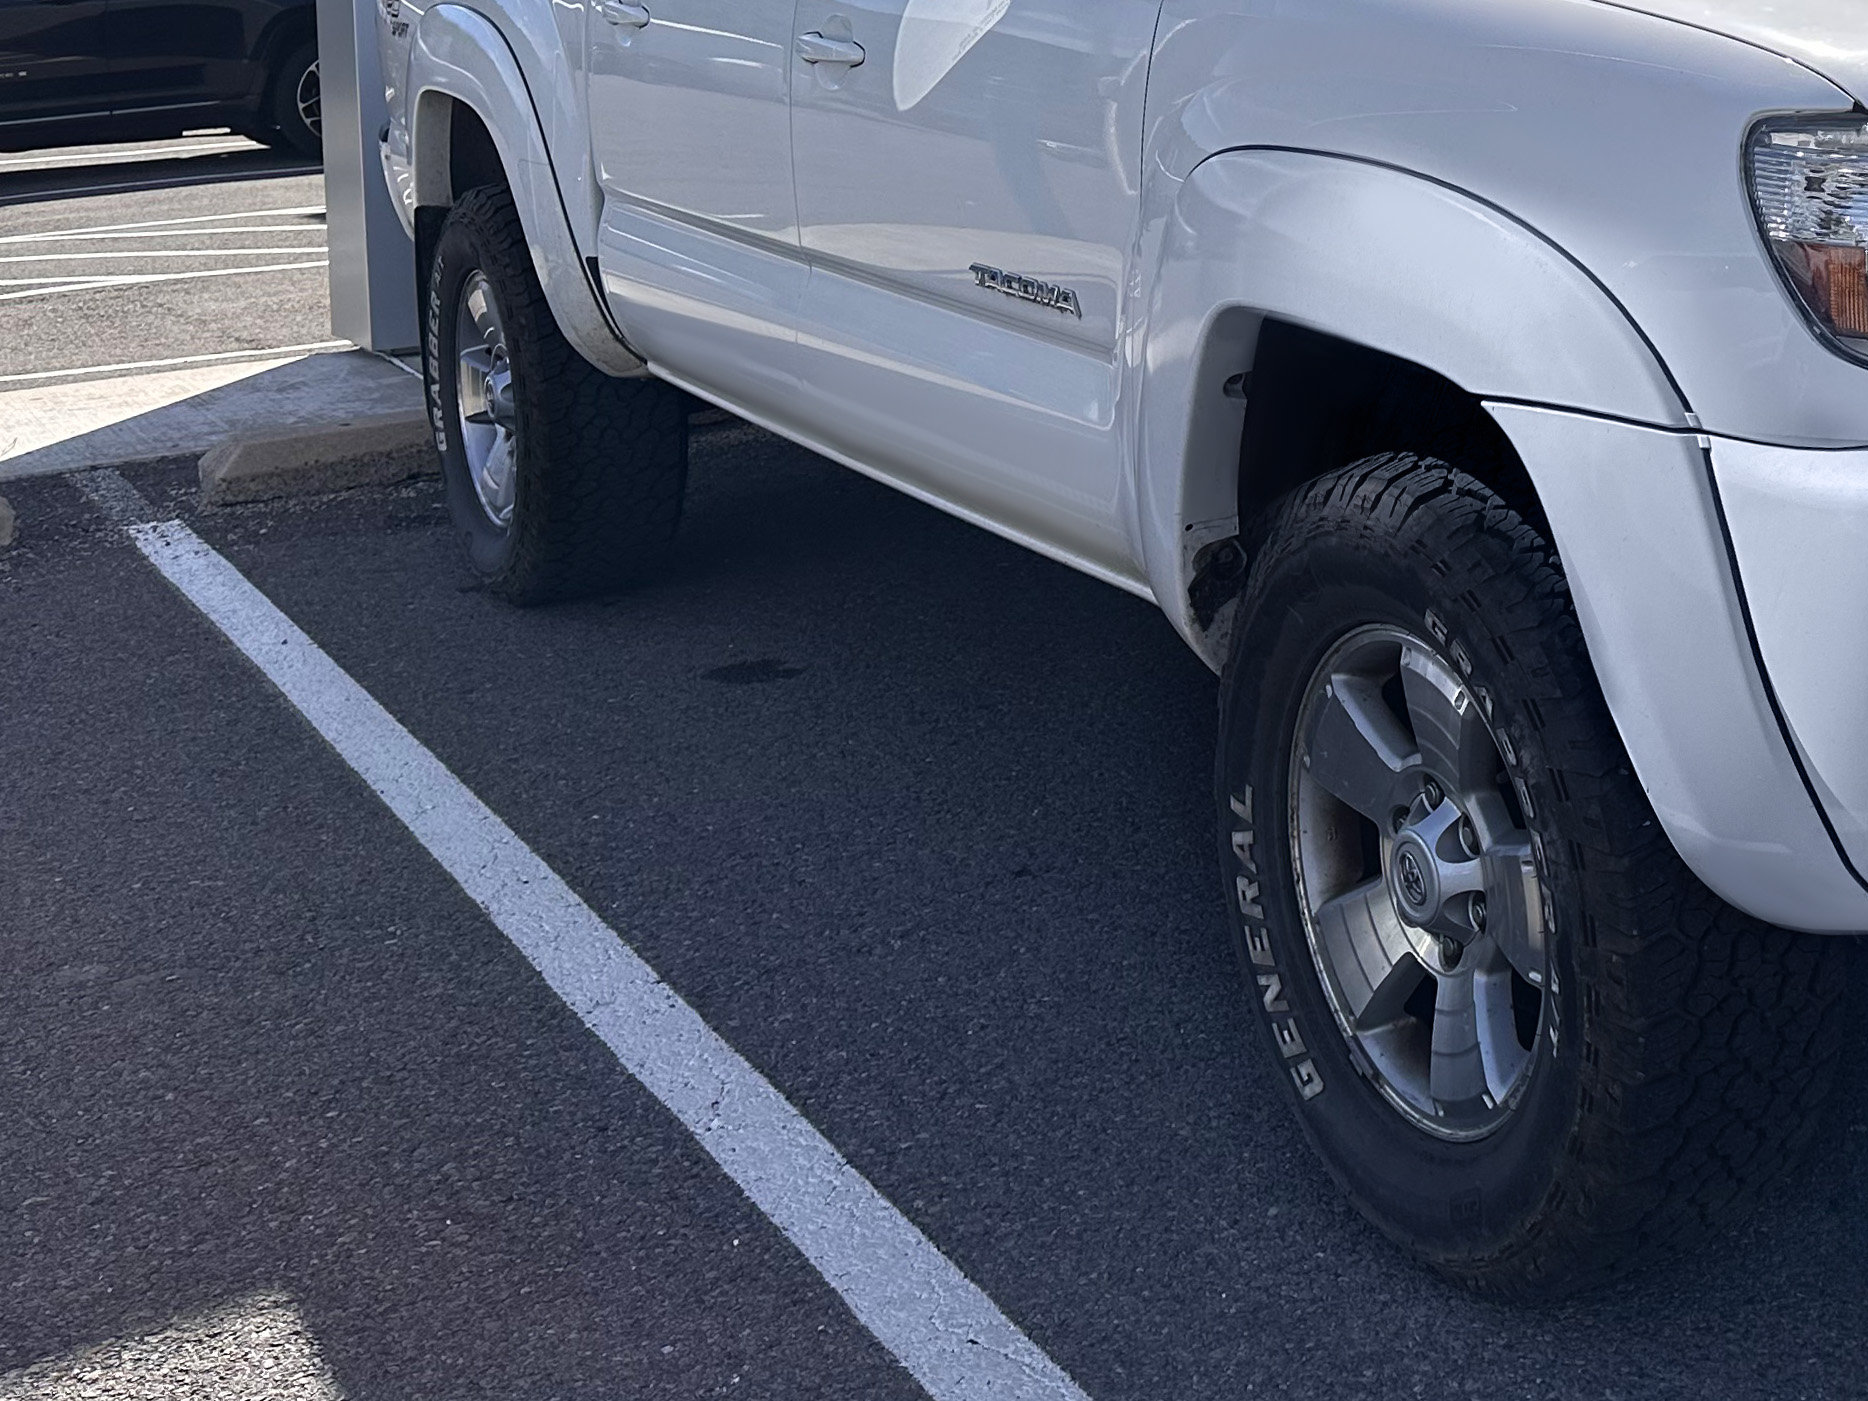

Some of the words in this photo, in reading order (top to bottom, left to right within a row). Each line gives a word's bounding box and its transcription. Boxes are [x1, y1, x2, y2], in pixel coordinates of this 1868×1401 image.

[428, 290, 448, 451] GRABBER
[968, 261, 1082, 320] TACOMA
[1229, 783, 1325, 1100] GENERAL
